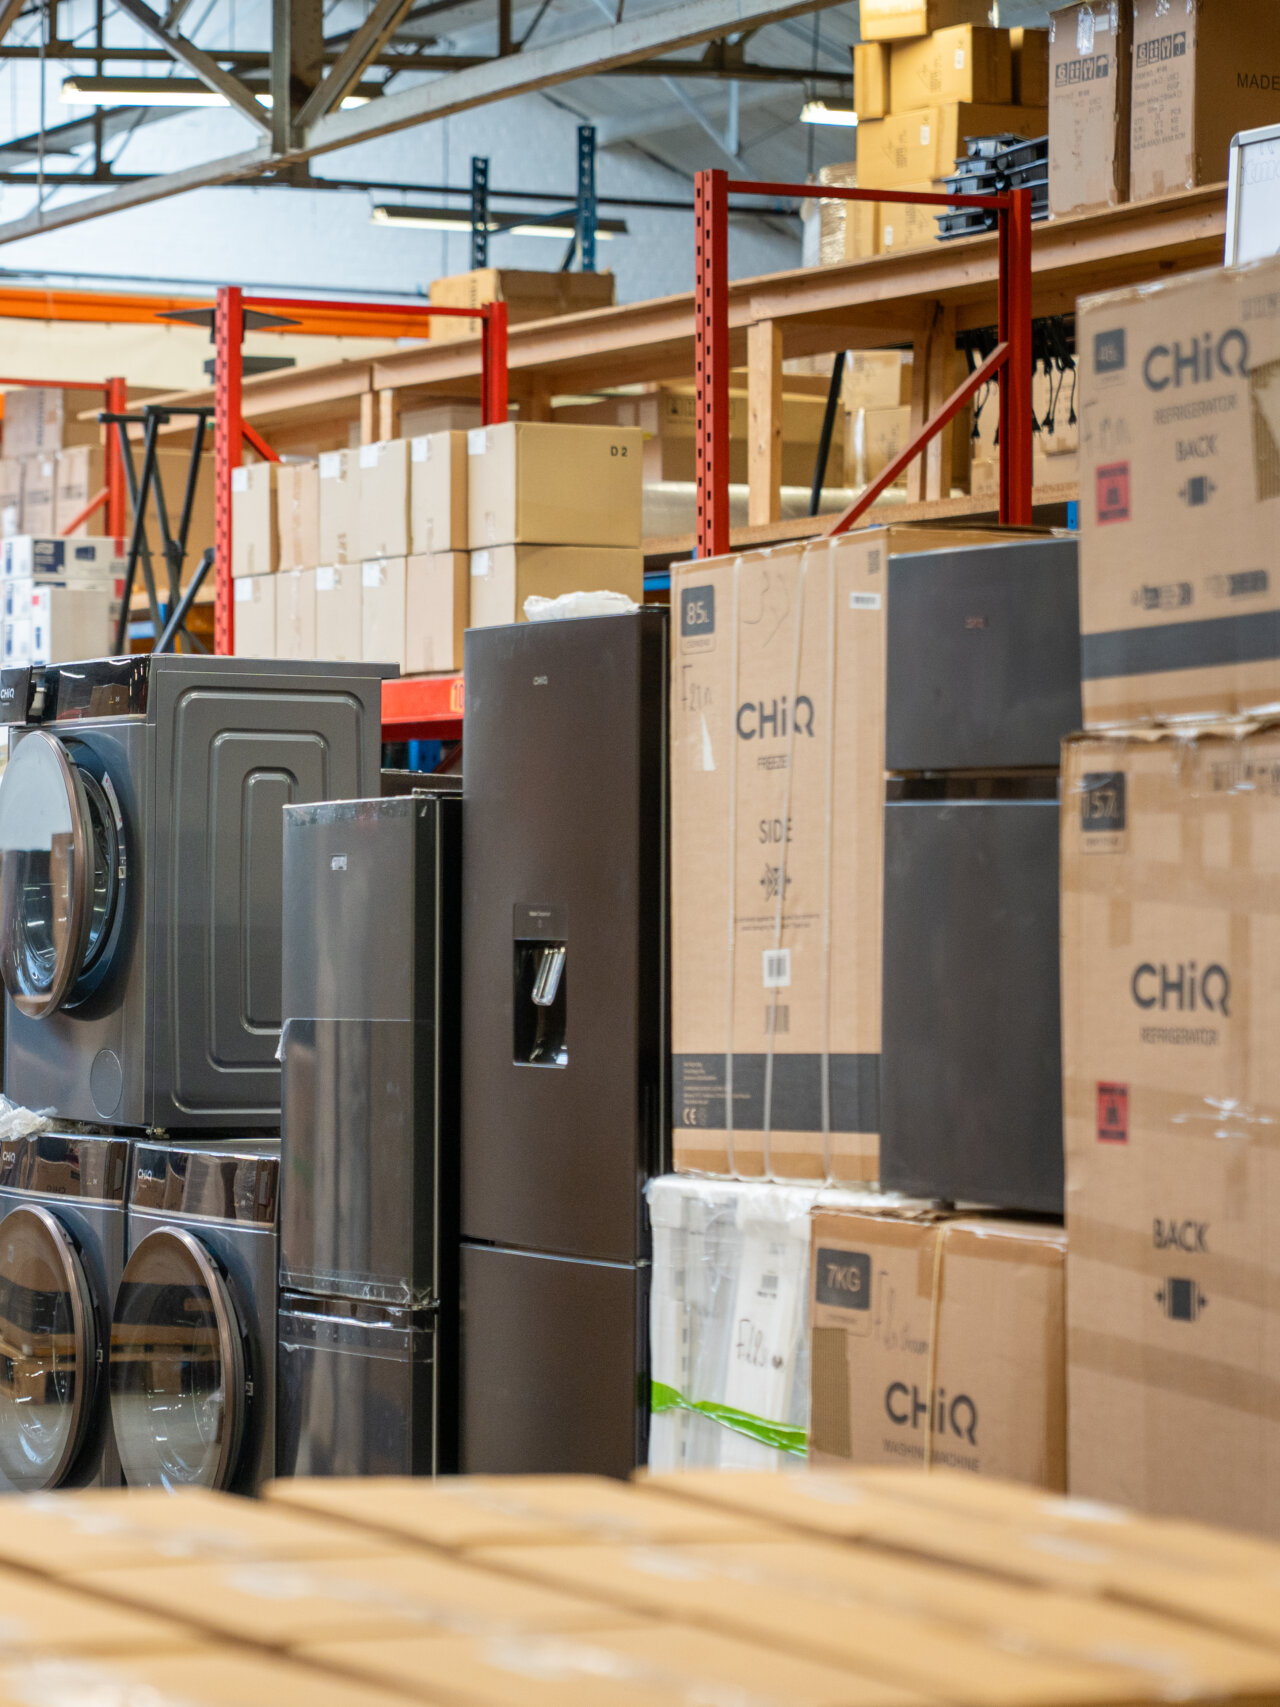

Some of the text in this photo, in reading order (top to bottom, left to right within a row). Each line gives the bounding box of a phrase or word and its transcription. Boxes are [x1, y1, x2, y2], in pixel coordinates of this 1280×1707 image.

[1236, 72, 1280, 91] MADE
[1143, 328, 1250, 392] CHiQ
[1175, 434, 1217, 462] BACK
[686, 601, 710, 625] 85L
[0, 688, 15, 699] CHiQ
[736, 695, 815, 740] CHiQ
[759, 818, 792, 844] SIDE
[1131, 960, 1231, 1018] CHiQ
[1152, 1217, 1212, 1254] BACK
[825, 1263, 862, 1292] 7KG
[885, 1380, 978, 1448] CHiQ
[882, 1438, 926, 1461] WASHIN
